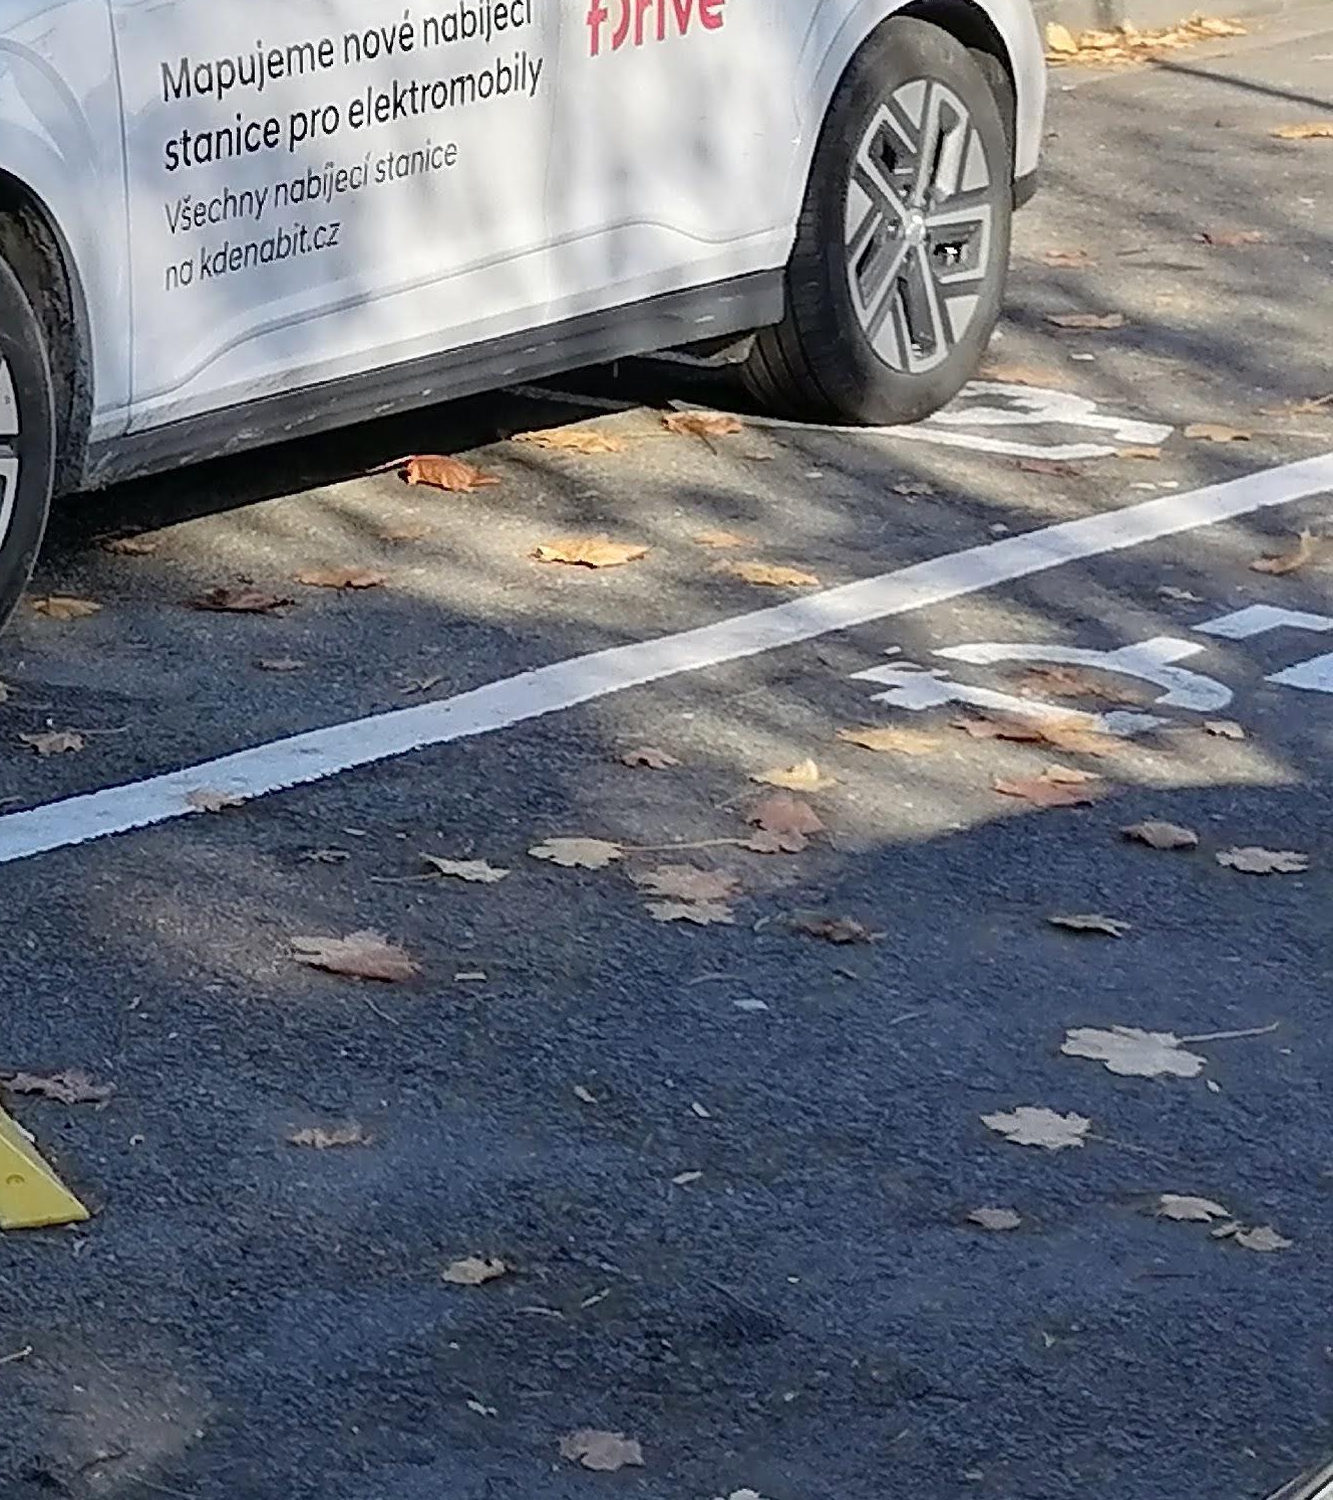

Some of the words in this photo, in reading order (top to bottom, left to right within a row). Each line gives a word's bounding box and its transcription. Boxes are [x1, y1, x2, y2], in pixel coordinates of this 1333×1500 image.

[161, 38, 334, 102] Mapujeme
[344, 8, 413, 65] nové
[165, 113, 280, 171] stanice
[289, 105, 339, 152] pro
[348, 51, 543, 128] elektromobily
[165, 187, 268, 234] Všechny
[375, 139, 457, 184] stanice
[165, 259, 193, 291] na
[200, 222, 340, 280] kdenabit.cz
